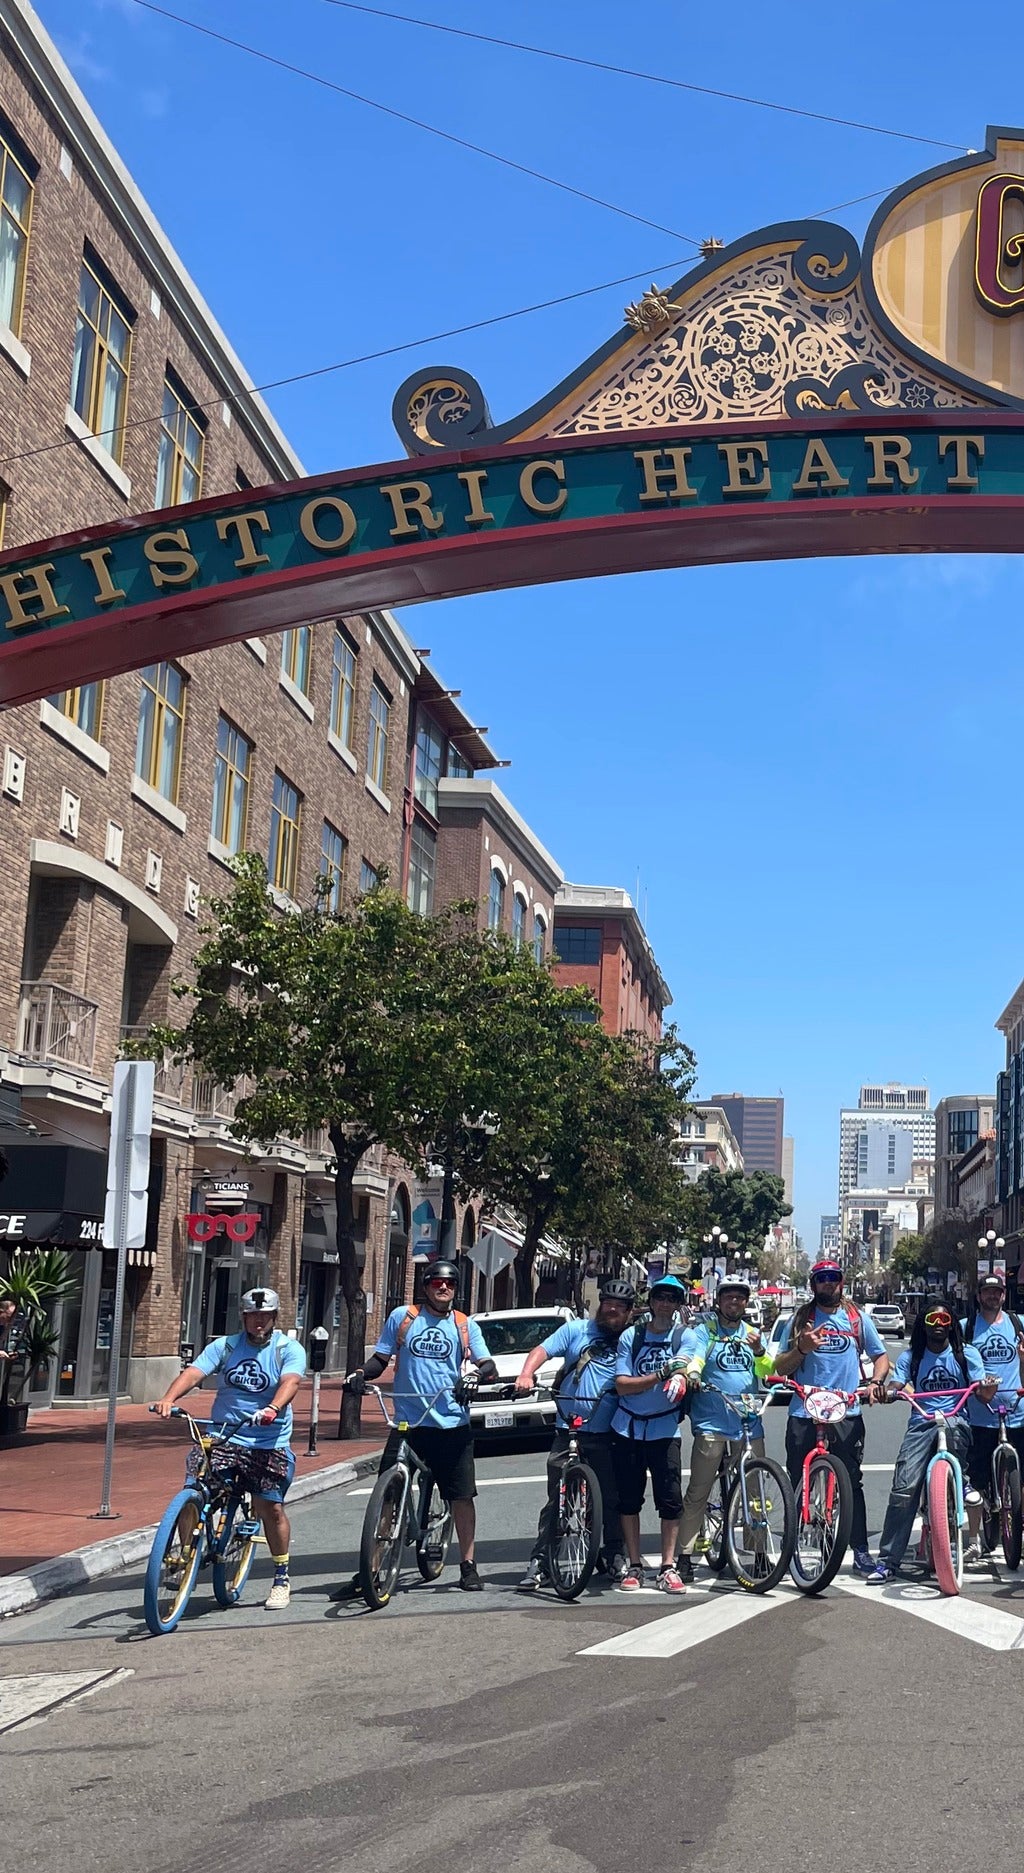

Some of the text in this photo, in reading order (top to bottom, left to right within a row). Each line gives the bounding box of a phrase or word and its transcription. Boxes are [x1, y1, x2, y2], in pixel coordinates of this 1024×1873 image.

[1, 459, 568, 629] HISTORIC
[635, 434, 986, 501] HEART
[80, 1220, 97, 1239] 224
[422, 1330, 442, 1343] SE
[420, 1342, 443, 1351] BIKES
[988, 1338, 1006, 1350] SE
[987, 1349, 1008, 1357] BIKES
[237, 1362, 257, 1378] SE
[932, 1370, 947, 1381] SE
[235, 1375, 259, 1386] BIKES
[929, 1381, 951, 1390] BIKES
